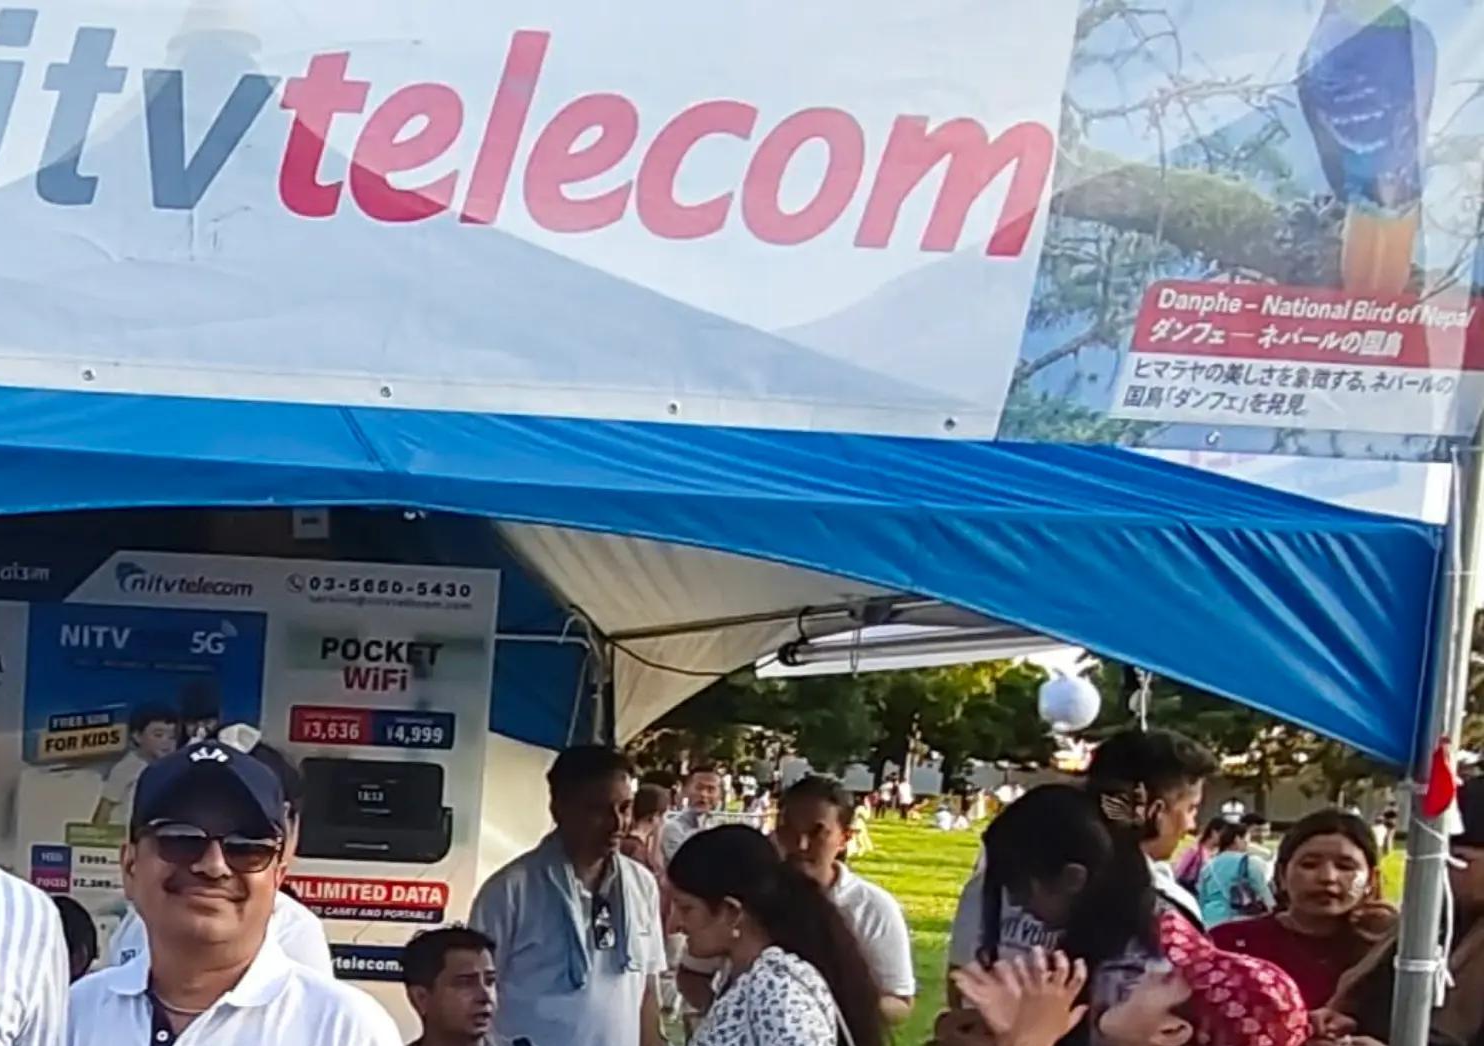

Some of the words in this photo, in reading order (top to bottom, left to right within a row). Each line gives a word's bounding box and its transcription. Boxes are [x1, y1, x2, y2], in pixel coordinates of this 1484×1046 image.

[1158, 288, 1242, 317] Danphe
[1261, 295, 1353, 320] National
[1352, 300, 1397, 323] Bird
[1396, 303, 1424, 325] of
[1420, 304, 1476, 333] Nepal
[60, 624, 131, 649] NITV
[190, 631, 226, 654] 5G
[320, 637, 443, 666] POCKET
[343, 665, 408, 692] WiFi
[44, 736, 77, 752] FOR
[81, 730, 121, 748] KIDS
[286, 881, 388, 903] NLIMITED
[392, 884, 443, 905] DATA
